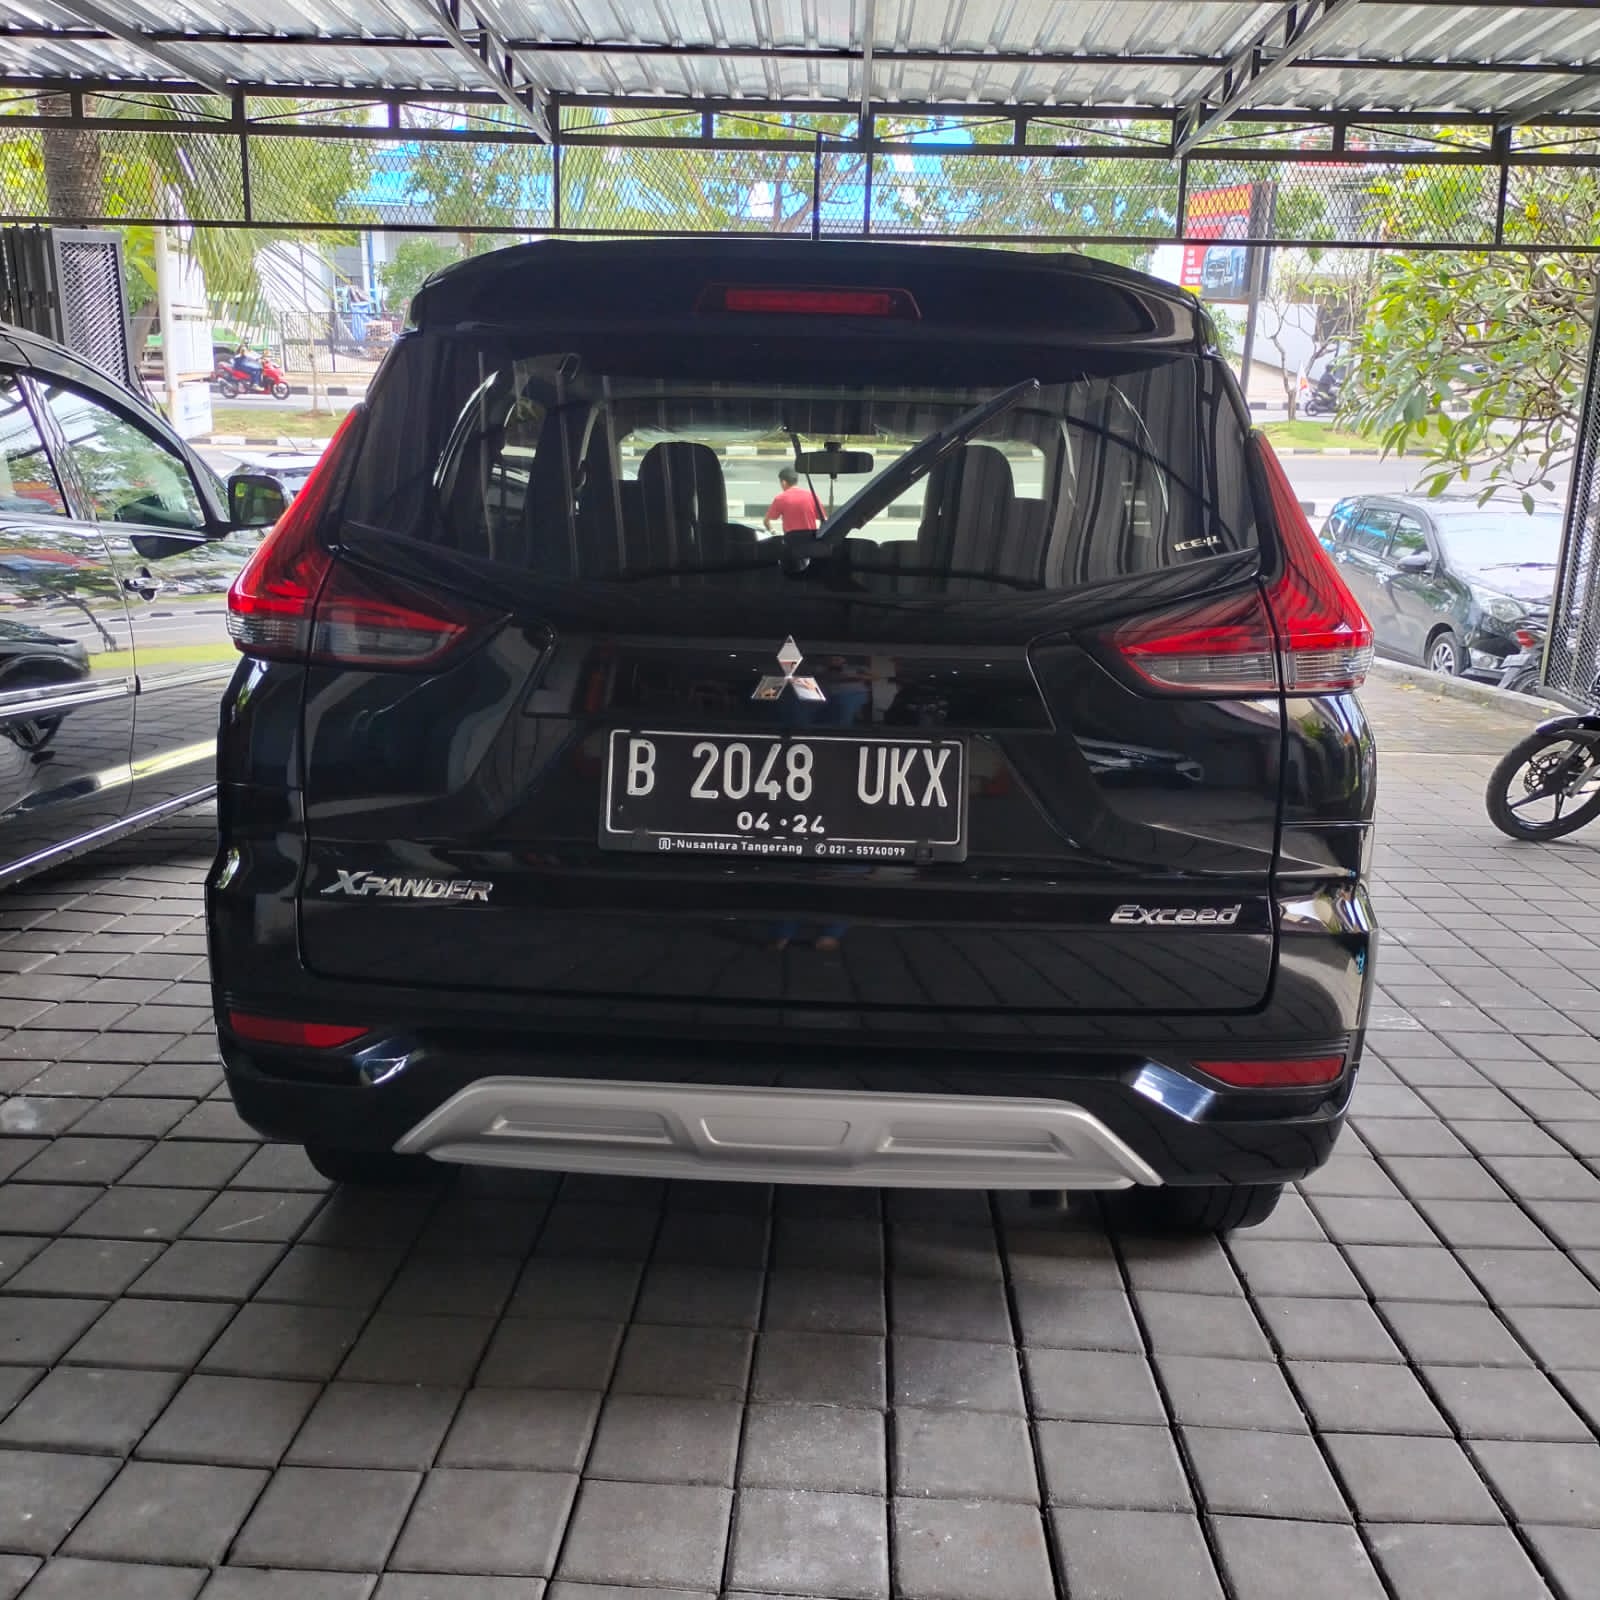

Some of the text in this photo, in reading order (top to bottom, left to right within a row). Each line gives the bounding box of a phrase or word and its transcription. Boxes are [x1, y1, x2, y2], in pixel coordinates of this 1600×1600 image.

[626, 738, 951, 808] B 2048 UKX
[741, 841, 803, 854] Tangerang
[320, 869, 494, 902] XPANDER
[1109, 903, 1242, 925] Exceed
